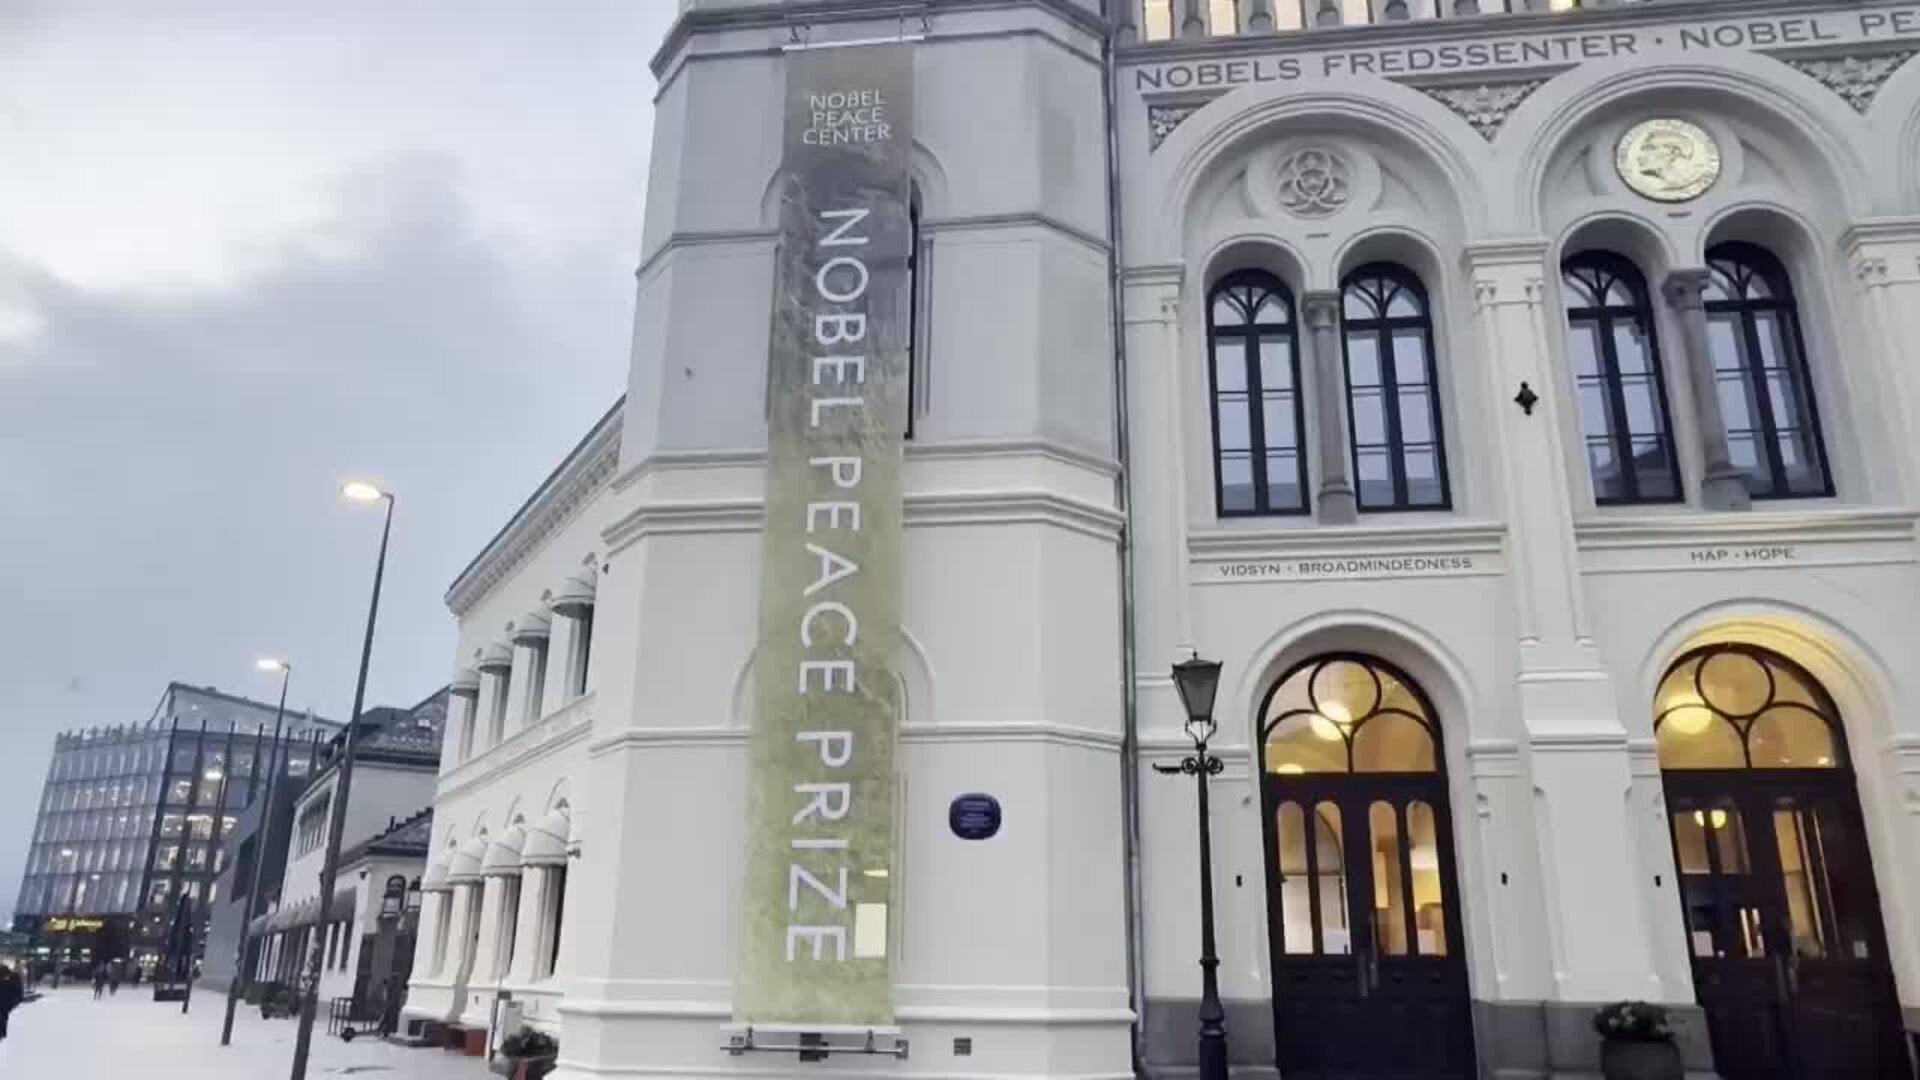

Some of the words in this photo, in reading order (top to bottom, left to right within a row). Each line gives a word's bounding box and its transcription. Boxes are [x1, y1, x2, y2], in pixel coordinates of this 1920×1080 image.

[1136, 58, 1302, 91] NOBELS
[1321, 33, 1637, 77] FREDSSENTER
[1680, 18, 1840, 51] NOBEL
[810, 88, 889, 111] NOBEL
[813, 106, 884, 128] PEACE
[803, 122, 893, 146] CENTER
[810, 208, 870, 428] NOBEL
[1691, 549, 1729, 561] HAP
[1744, 547, 1795, 560] HOPE
[799, 456, 862, 694] PEACE
[1220, 563, 1281, 577] VIDSYN
[1299, 556, 1473, 575] BROADMINDEDNESS
[786, 731, 853, 961] PRIZE
